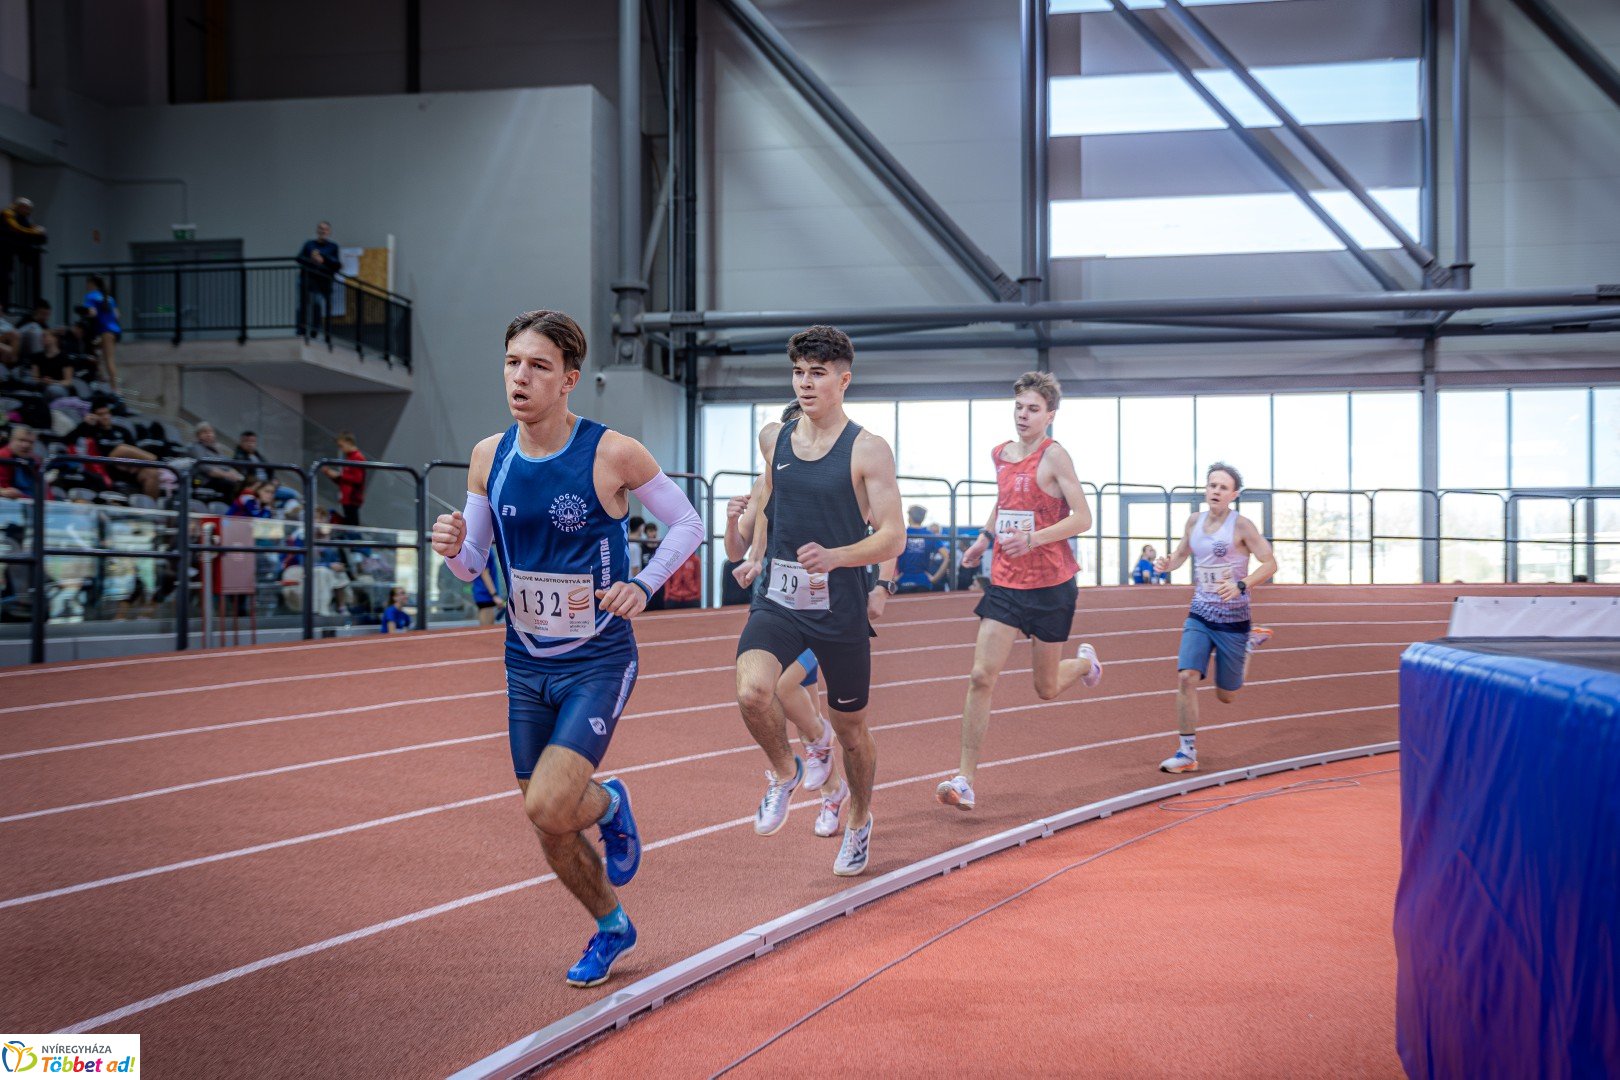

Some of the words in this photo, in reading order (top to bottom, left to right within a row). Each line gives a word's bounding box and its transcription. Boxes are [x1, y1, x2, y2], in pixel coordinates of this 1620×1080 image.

[571, 494, 588, 514] NITRA
[552, 520, 587, 533] ATLETIKA
[599, 536, 611, 567] NITRA
[780, 573, 798, 594] 29
[520, 588, 562, 617] 132
